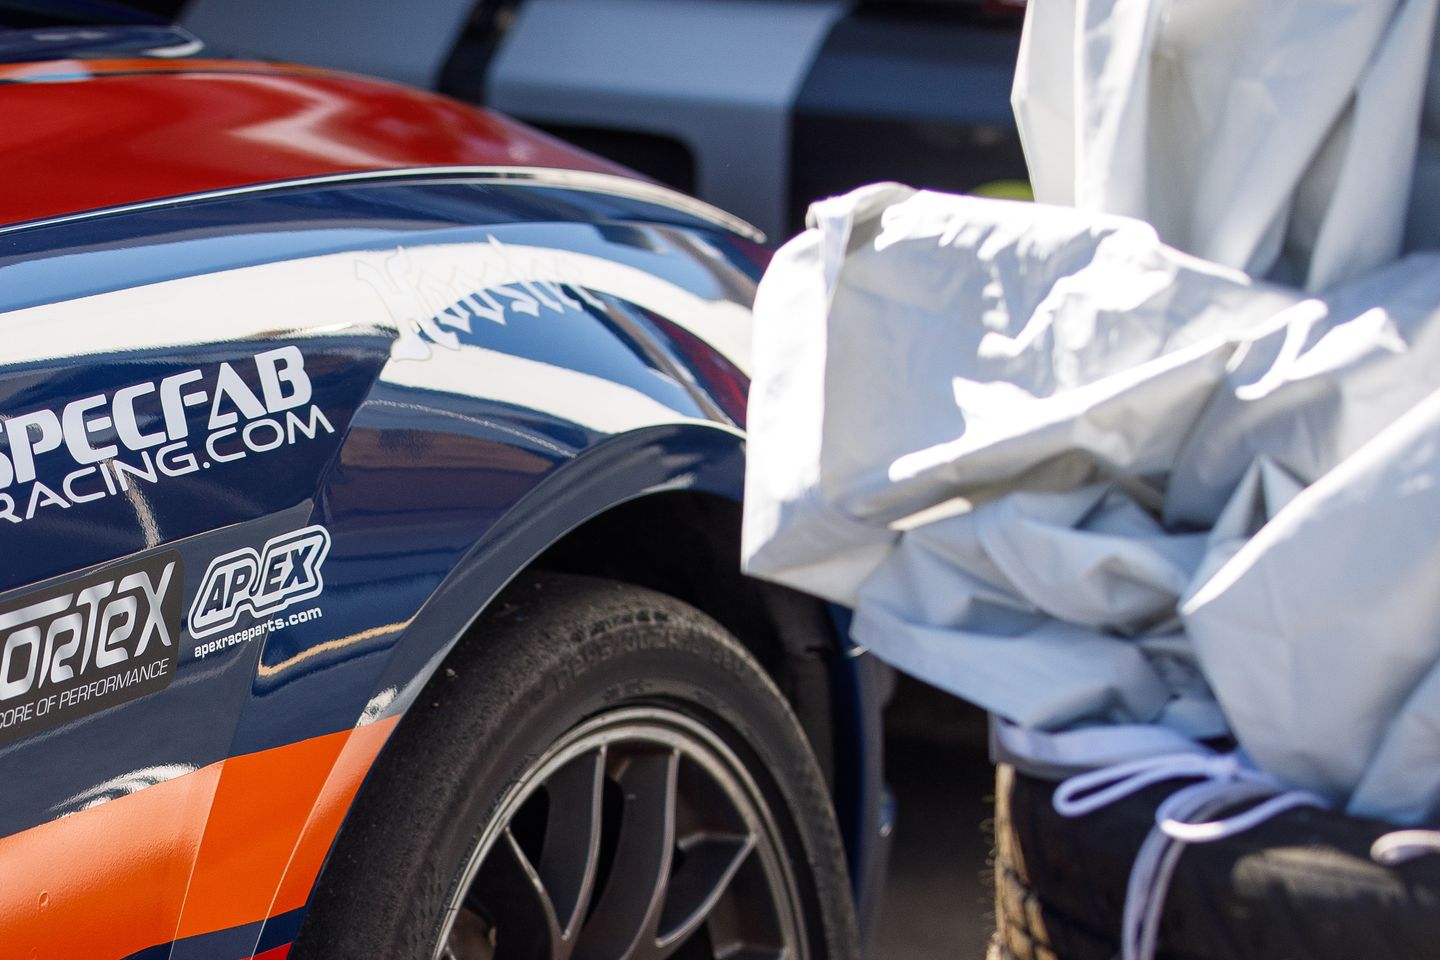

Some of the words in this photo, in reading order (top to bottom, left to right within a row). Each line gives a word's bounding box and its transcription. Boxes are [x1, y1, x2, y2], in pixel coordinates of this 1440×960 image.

[196, 536, 321, 624] APEX
[194, 607, 322, 659] apexraceparts.com
[36, 699, 56, 718] OF
[59, 657, 169, 710] PERFORMANCE
